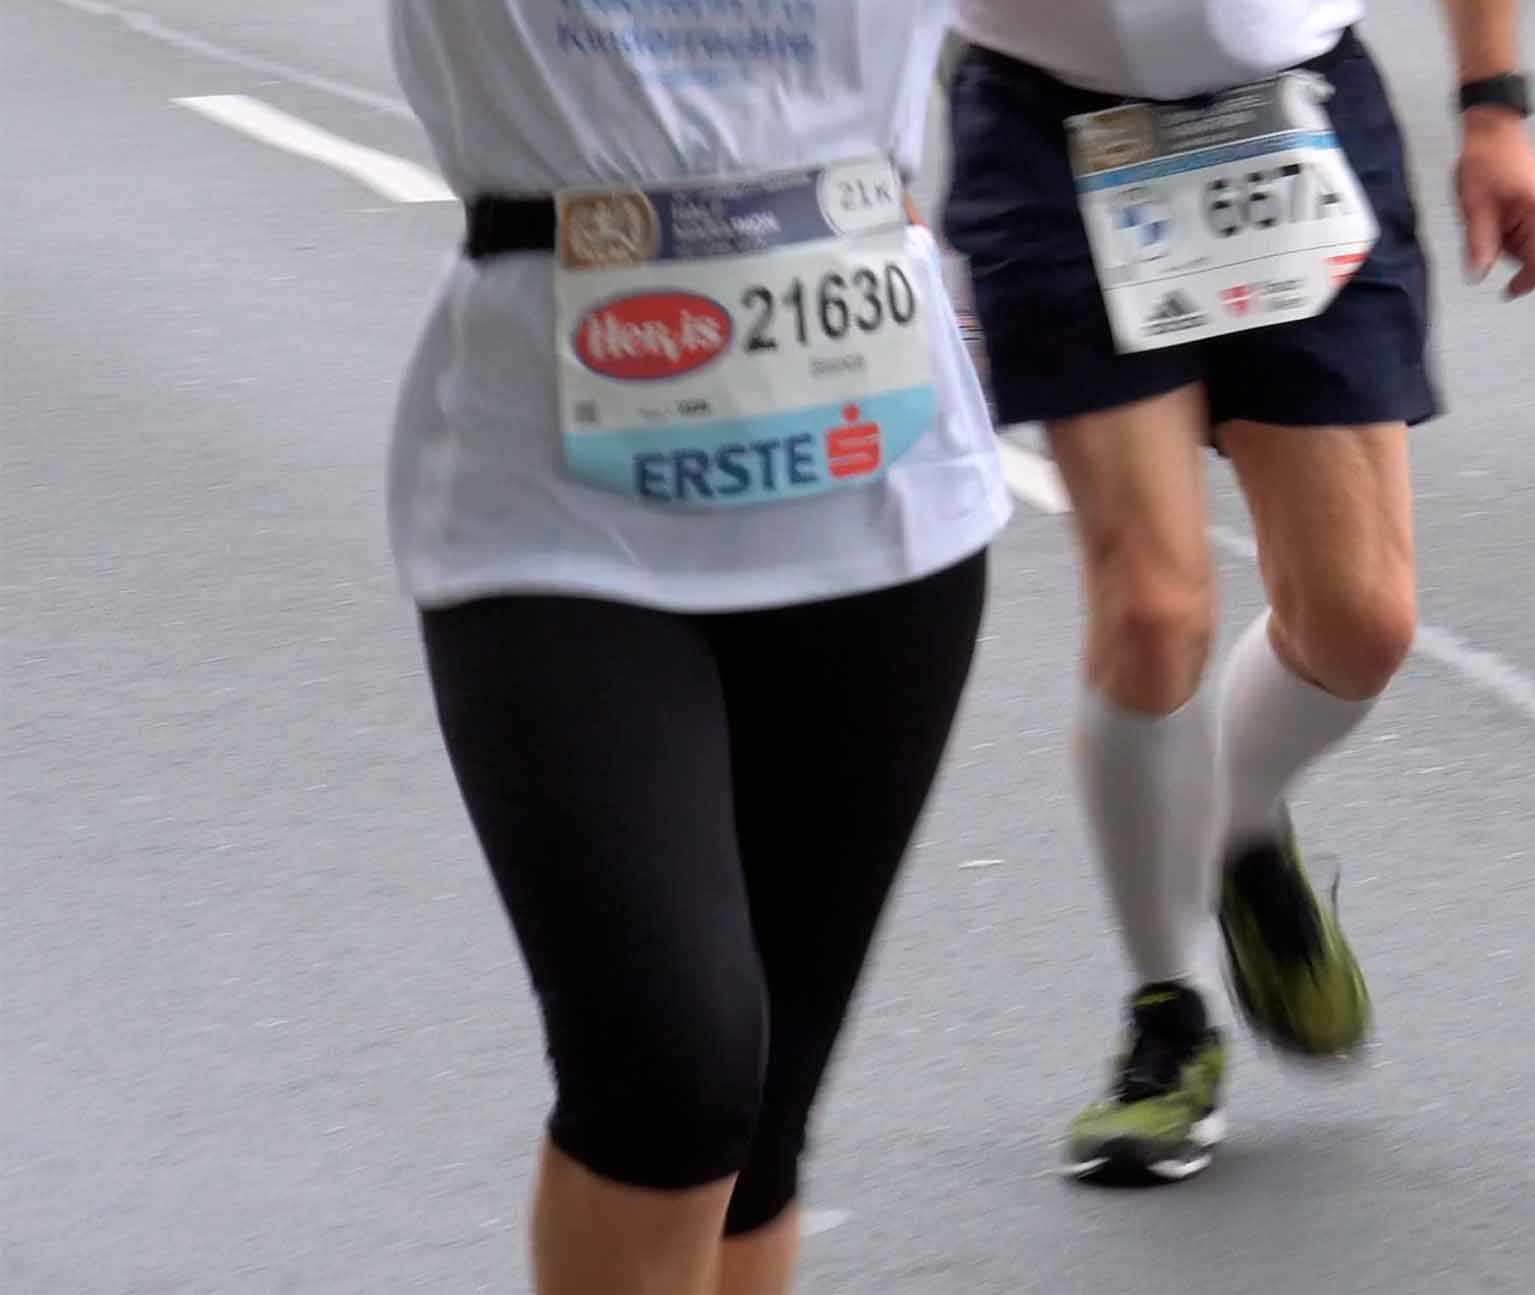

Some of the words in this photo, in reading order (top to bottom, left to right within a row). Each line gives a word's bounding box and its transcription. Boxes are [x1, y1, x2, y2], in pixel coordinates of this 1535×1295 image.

[1203, 160, 1345, 239] 667A
[739, 262, 917, 353] 21630
[632, 432, 820, 503] ERSTE
